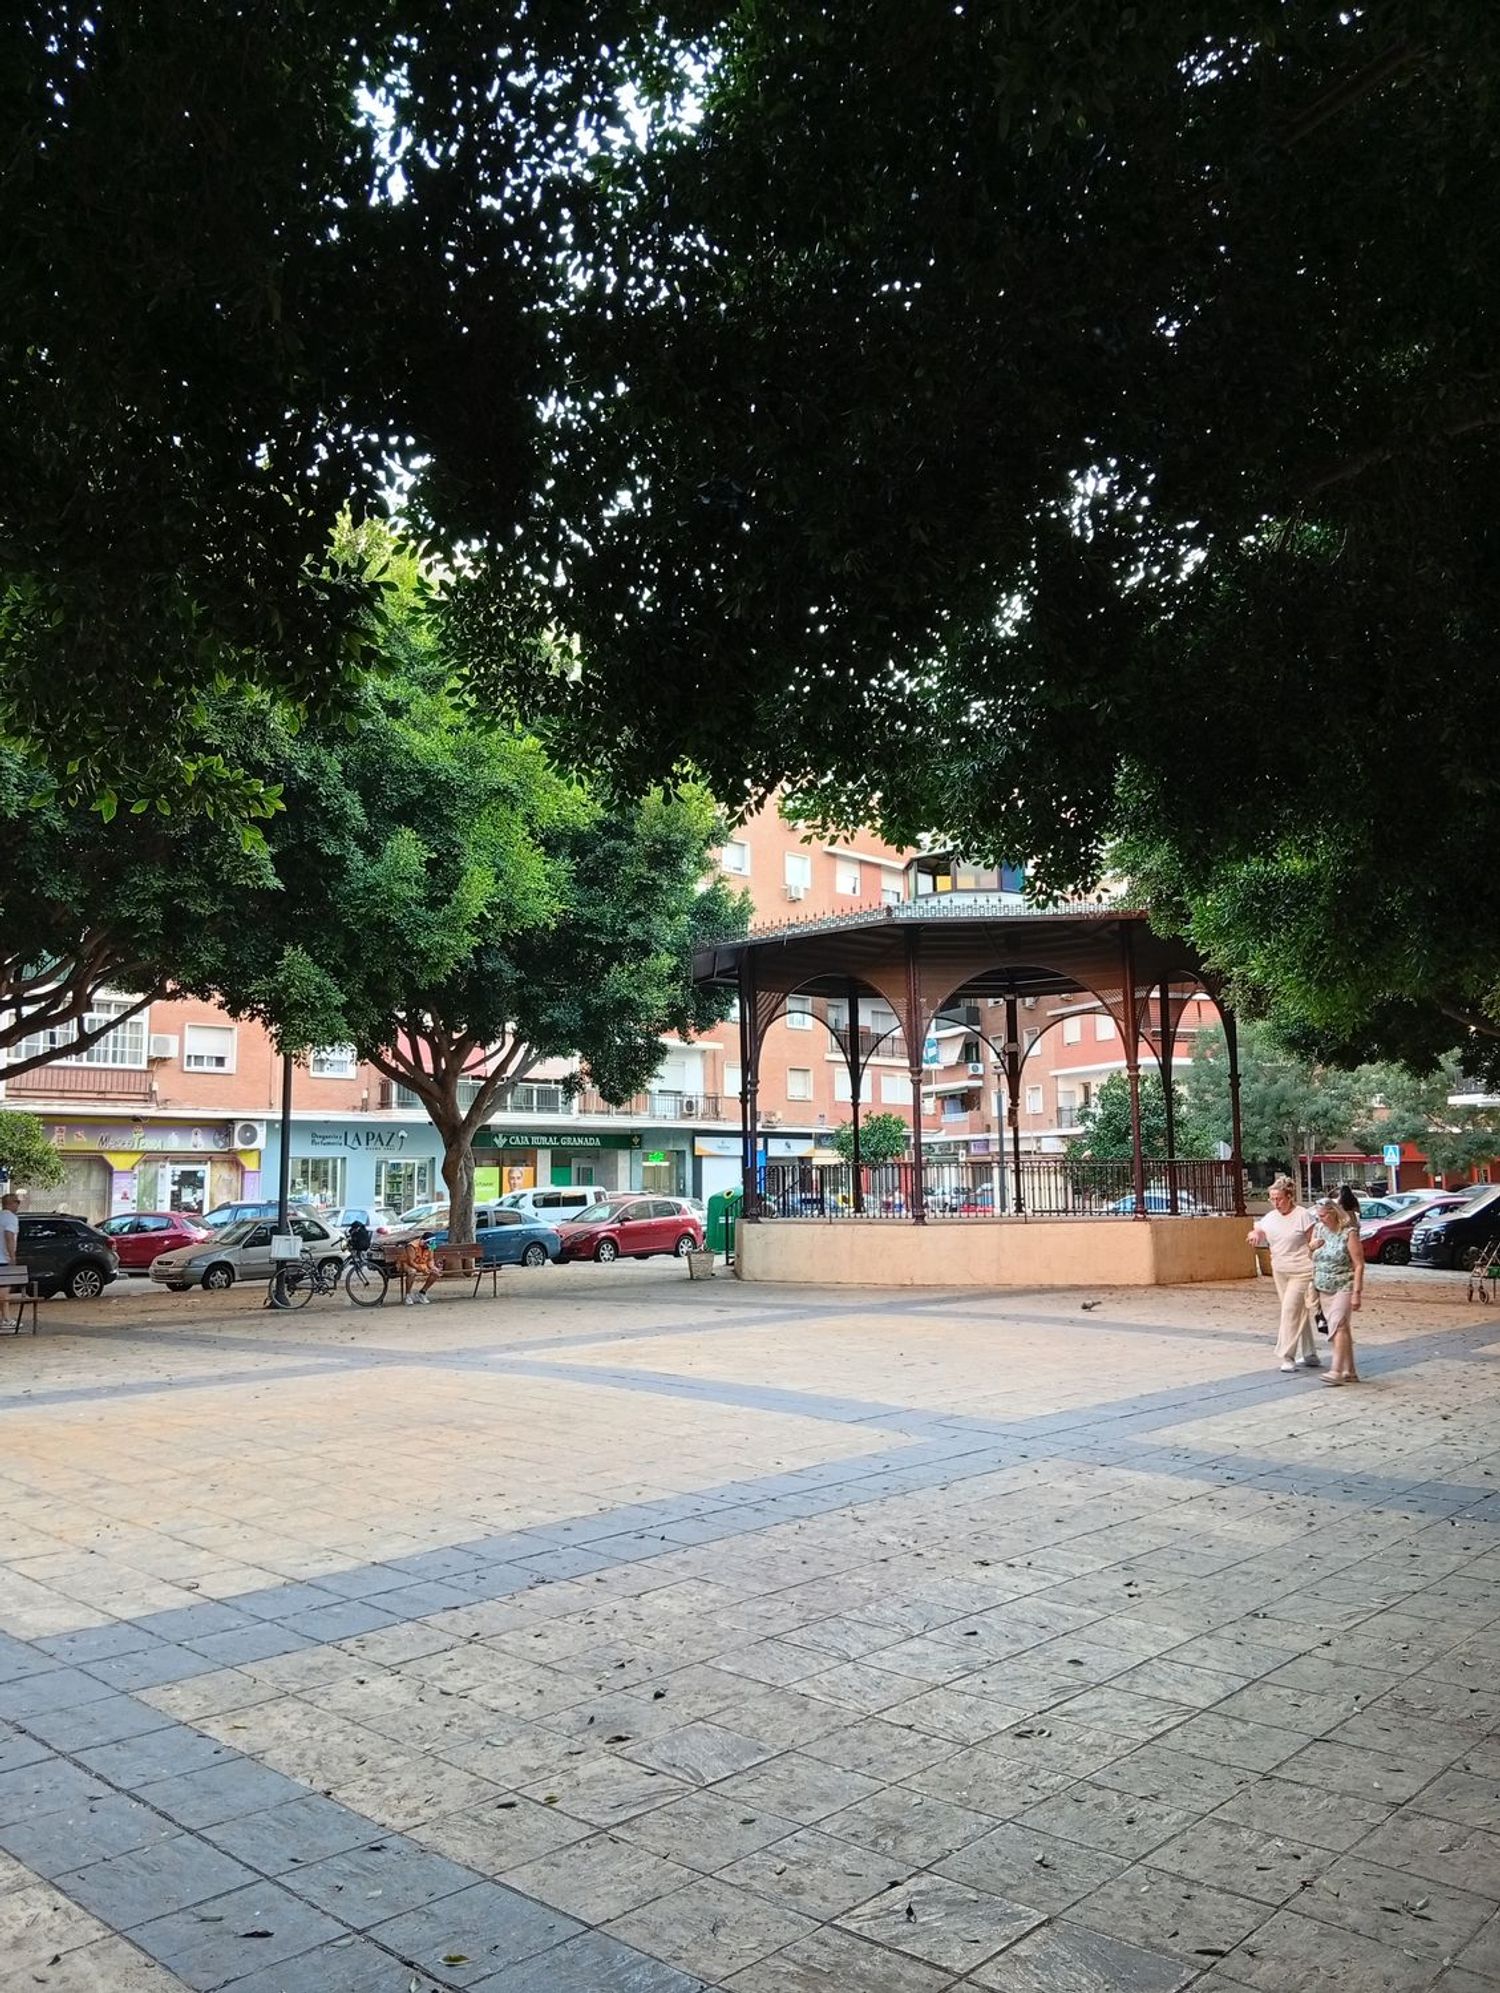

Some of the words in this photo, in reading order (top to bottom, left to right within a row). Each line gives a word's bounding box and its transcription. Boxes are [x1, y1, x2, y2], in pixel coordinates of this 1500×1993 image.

[344, 1131, 362, 1150] LA
[366, 1131, 395, 1146] PAZ
[509, 1136, 529, 1145] CAJA
[531, 1136, 559, 1145] RURAL
[560, 1136, 601, 1146] GRANADA
